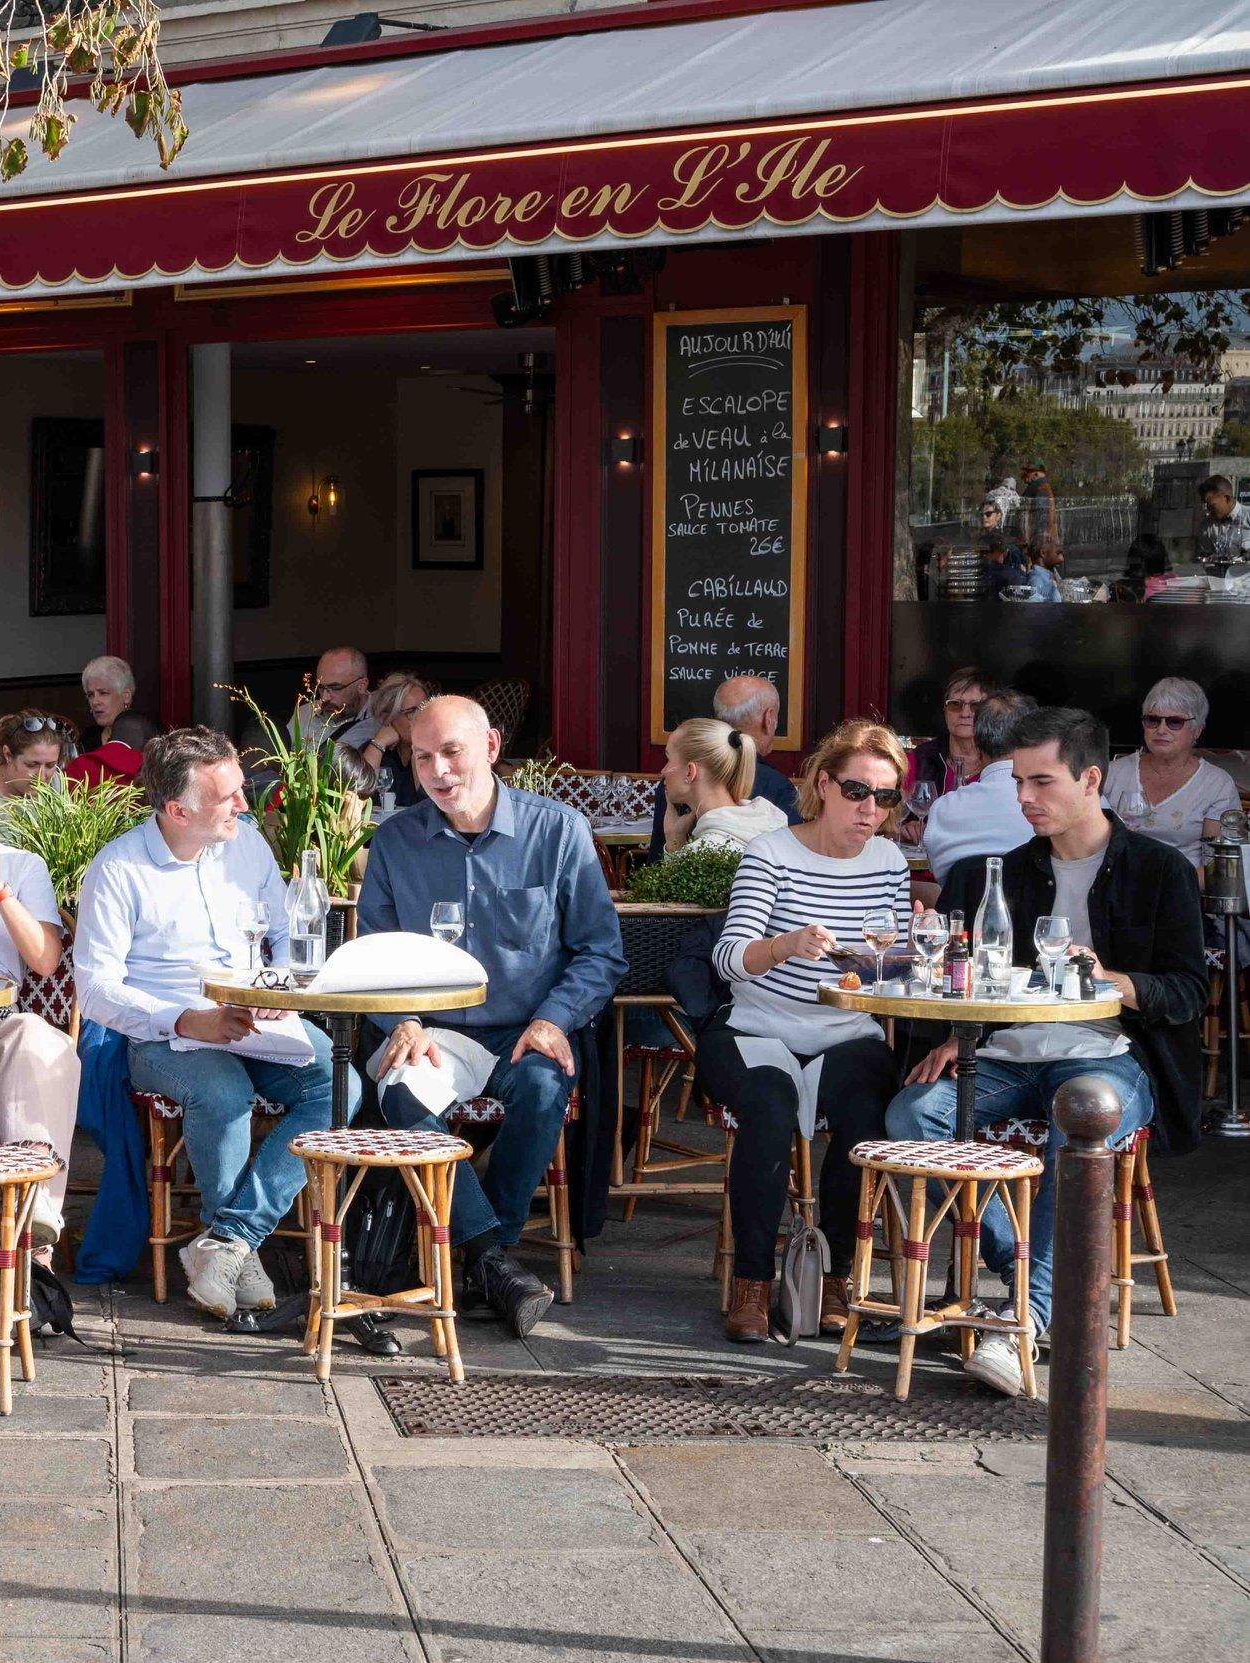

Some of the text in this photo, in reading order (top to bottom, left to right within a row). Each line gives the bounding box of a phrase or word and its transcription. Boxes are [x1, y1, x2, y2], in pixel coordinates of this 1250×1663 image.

[295, 181, 377, 243] Le
[386, 172, 554, 234] Flore
[561, 181, 651, 218] en
[682, 390, 791, 416] ESCALOPE
[674, 433, 689, 450] de
[692, 425, 752, 450] VEAU
[772, 421, 792, 439] la
[680, 493, 754, 519] PENNES
[668, 518, 780, 537] SAUCE TOMATE
[750, 536, 787, 556] 26€
[677, 607, 765, 629] PURÉE de
[669, 635, 788, 659] POMME de TERRE
[669, 667, 714, 680] SAUCE
